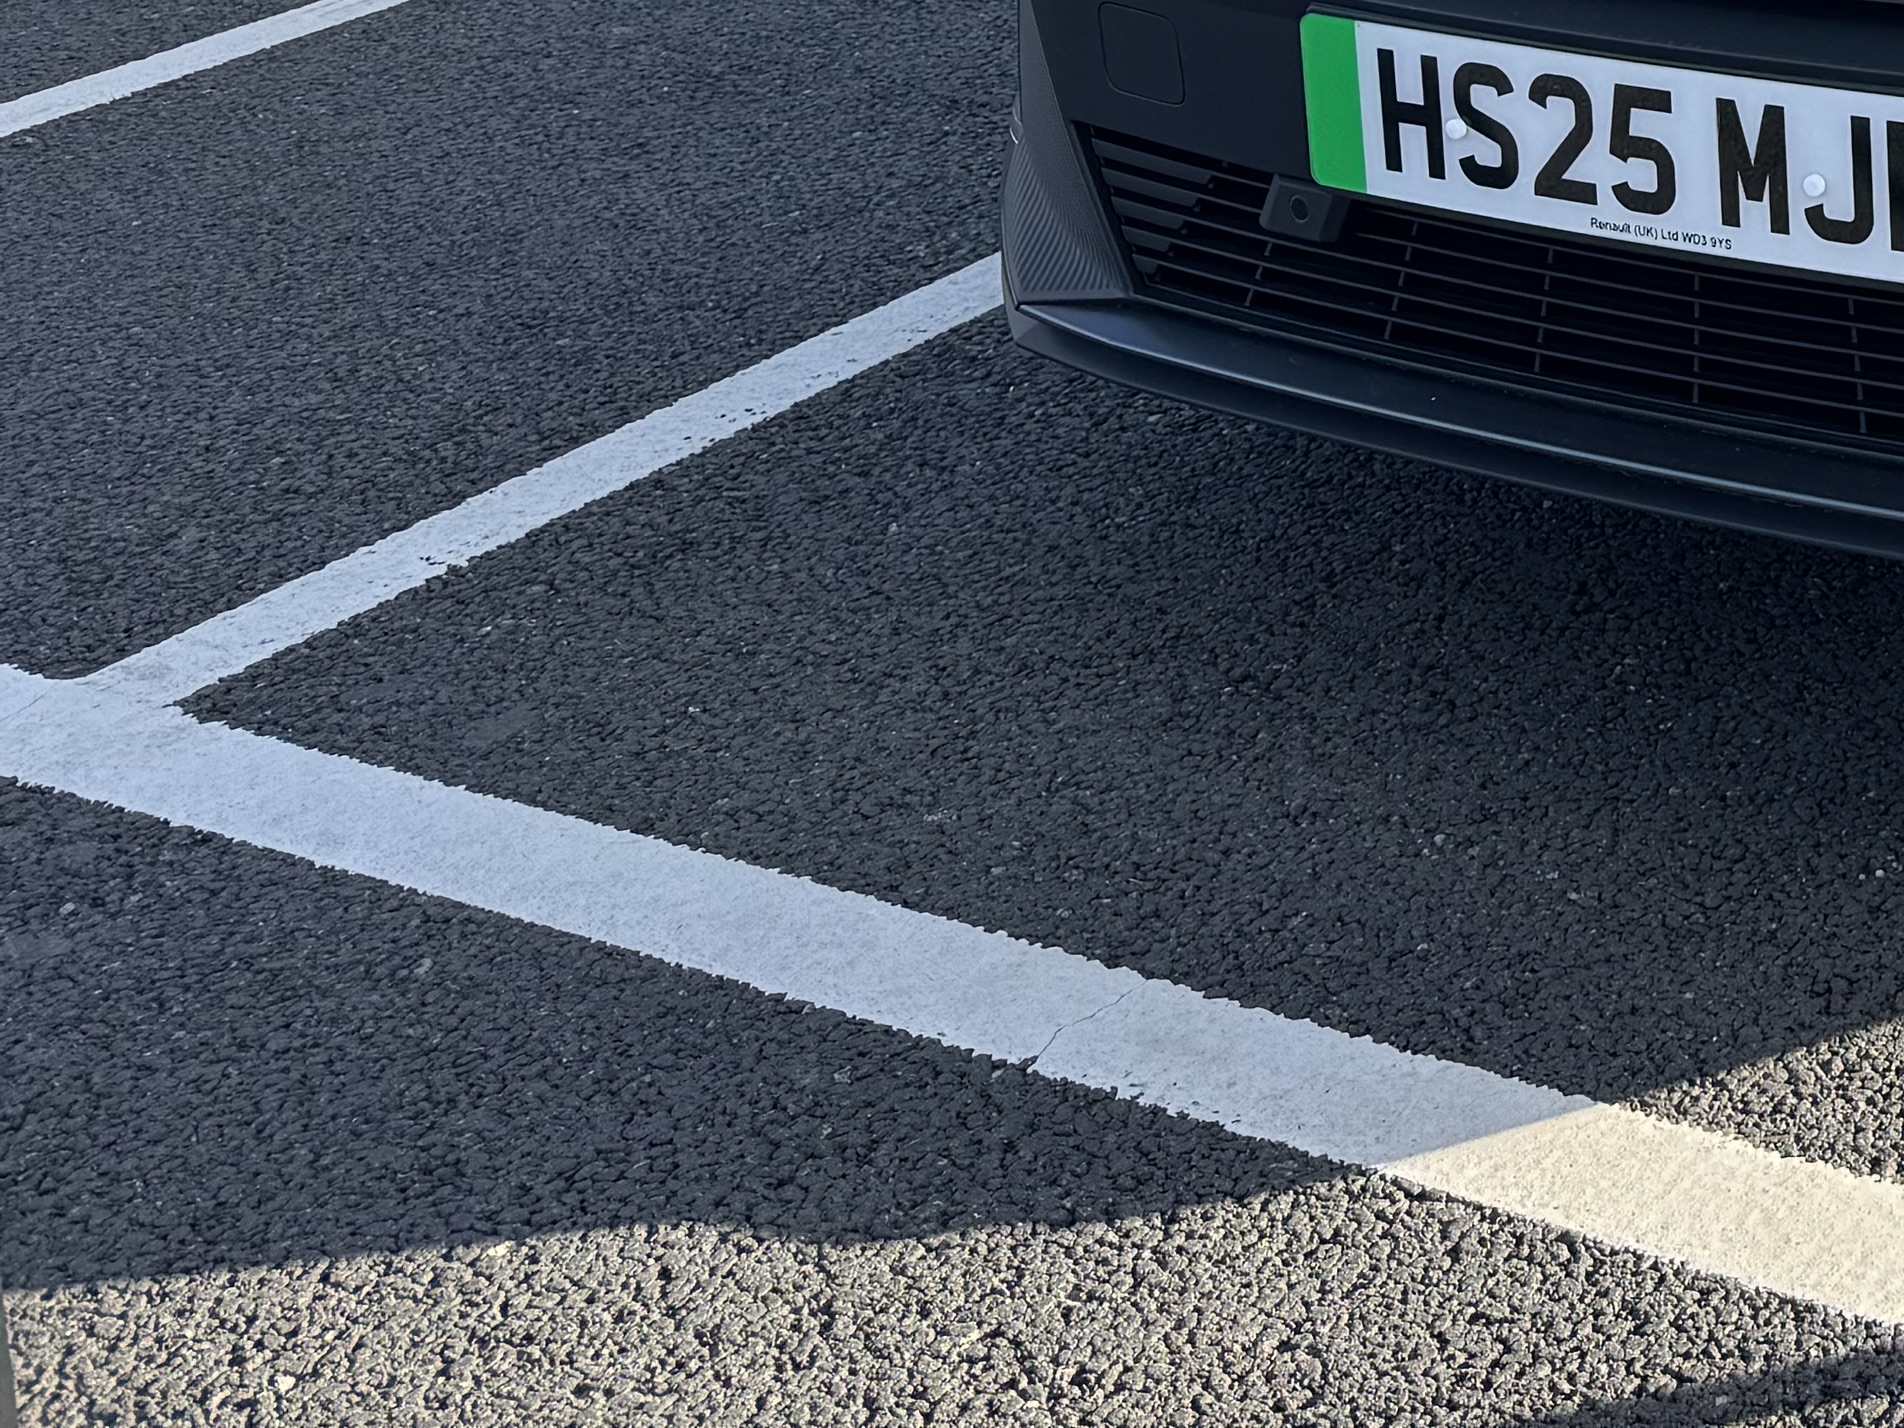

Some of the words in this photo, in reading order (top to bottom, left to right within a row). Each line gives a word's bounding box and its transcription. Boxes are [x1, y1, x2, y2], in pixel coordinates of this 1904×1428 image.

[1376, 47, 1676, 216] HS25
[1590, 217, 1631, 234] Renault
[1634, 224, 1659, 241] (UK)
[1661, 228, 1679, 242] Ltd
[1710, 236, 1733, 251] 9YS
